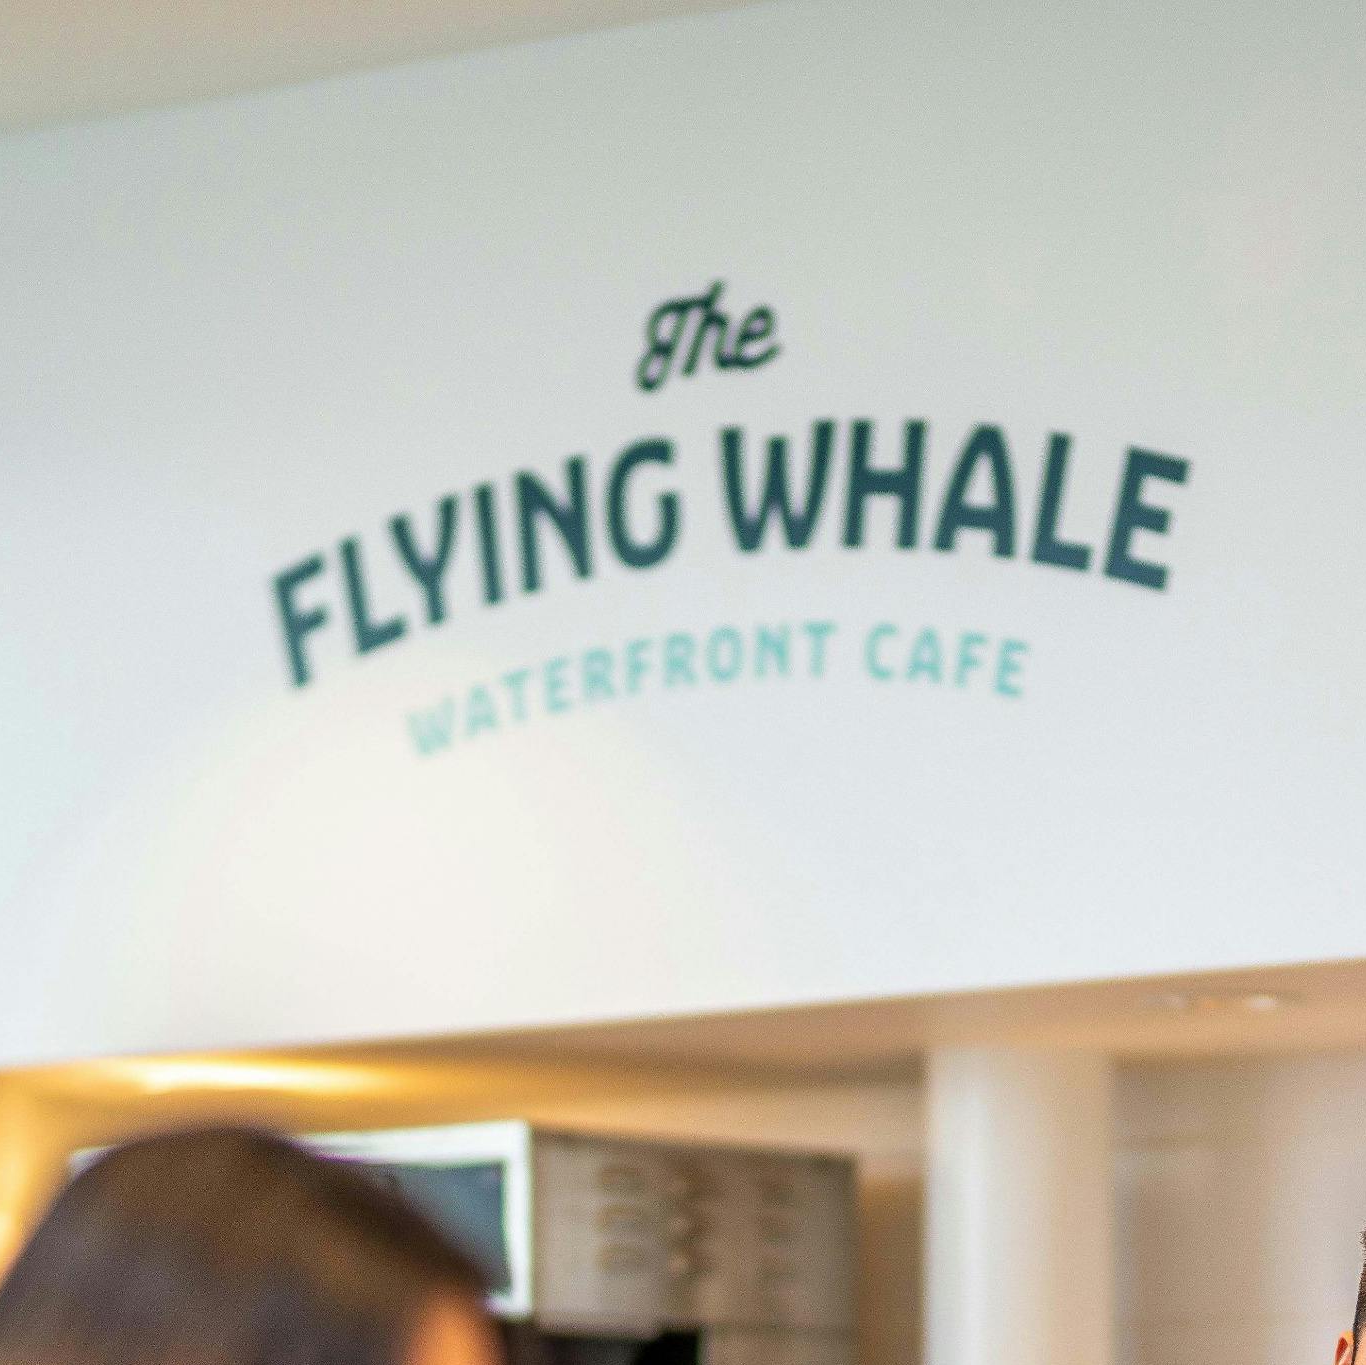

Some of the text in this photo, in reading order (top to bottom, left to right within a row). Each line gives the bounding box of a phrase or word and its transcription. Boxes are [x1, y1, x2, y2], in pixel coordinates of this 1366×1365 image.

[634, 280, 782, 393] The
[272, 416, 1192, 690] FLYING WHALE
[406, 620, 1032, 757] WATERFRONT CAFE
